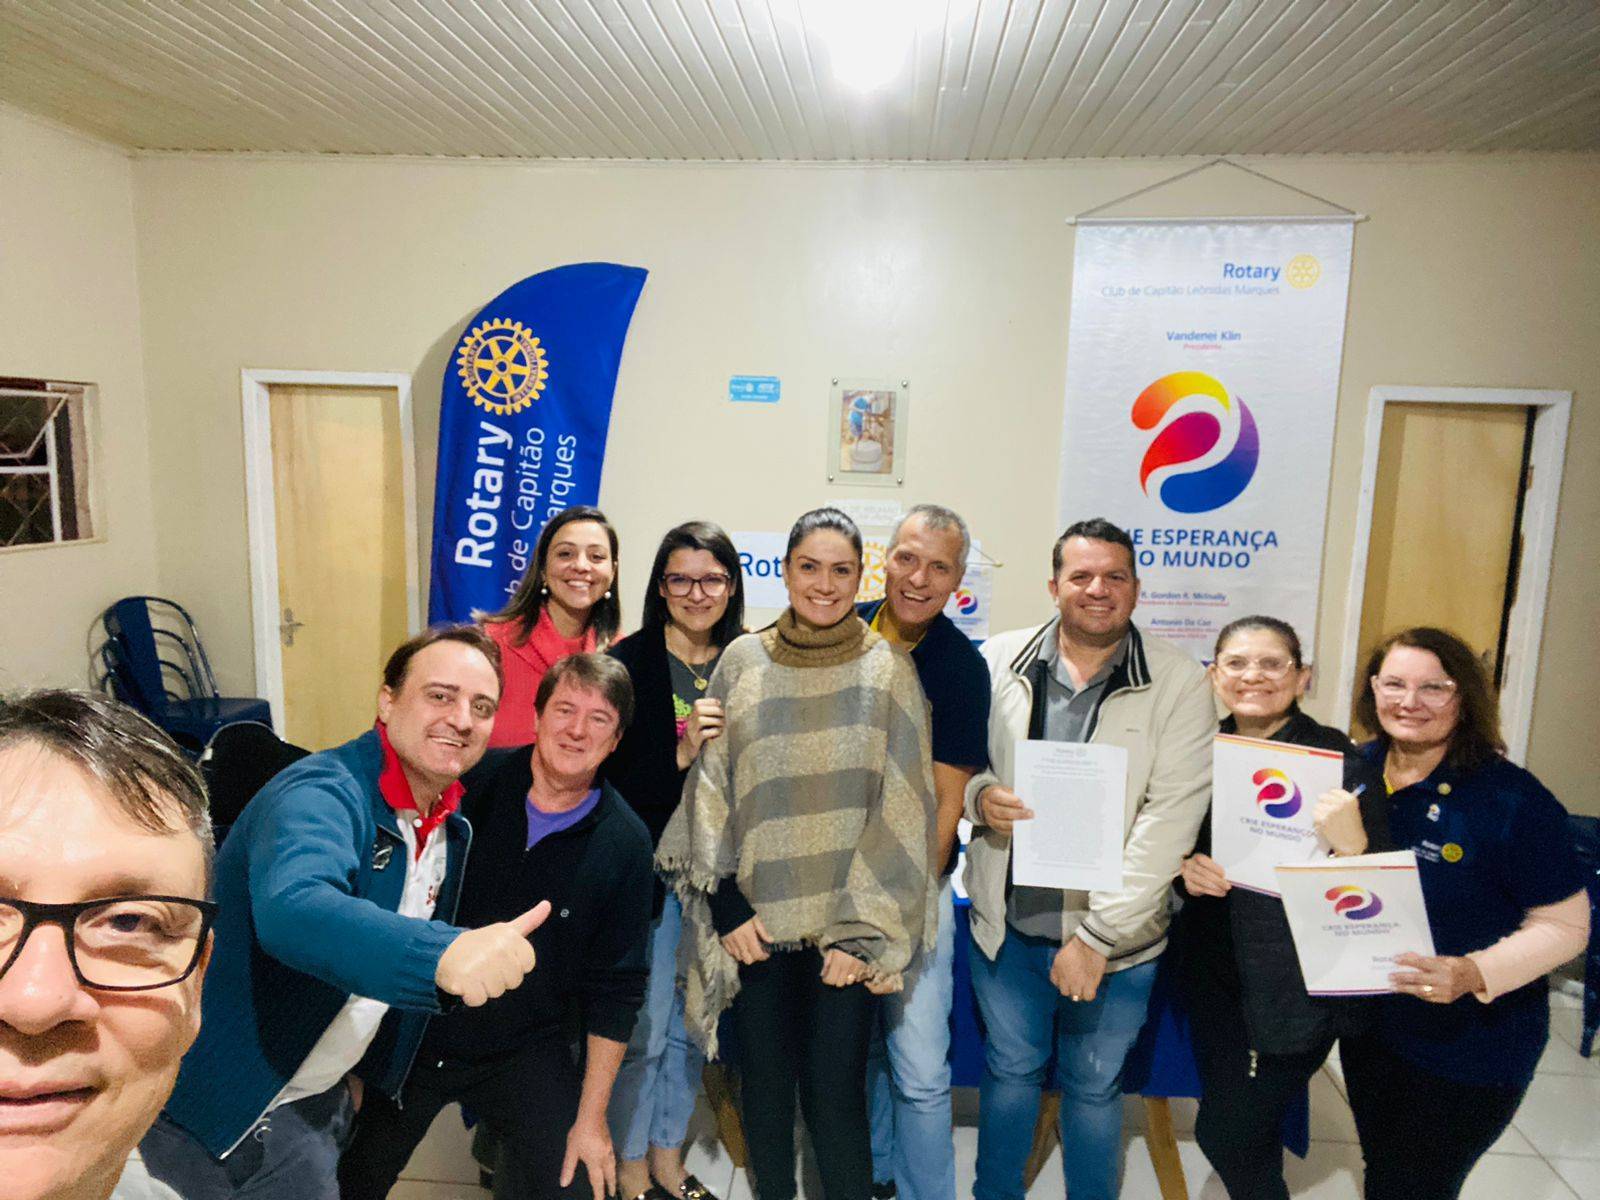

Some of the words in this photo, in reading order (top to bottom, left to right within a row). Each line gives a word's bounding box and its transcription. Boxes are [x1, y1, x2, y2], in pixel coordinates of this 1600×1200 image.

[1223, 263, 1281, 281] Rotary
[511, 427, 545, 531] Capitão
[541, 433, 577, 527] arques
[454, 420, 514, 568] Rotary
[1151, 528, 1278, 552] ESPERANÇA
[507, 539, 529, 571] de
[738, 552, 783, 578] Rot
[1163, 550, 1251, 569] MUNDO
